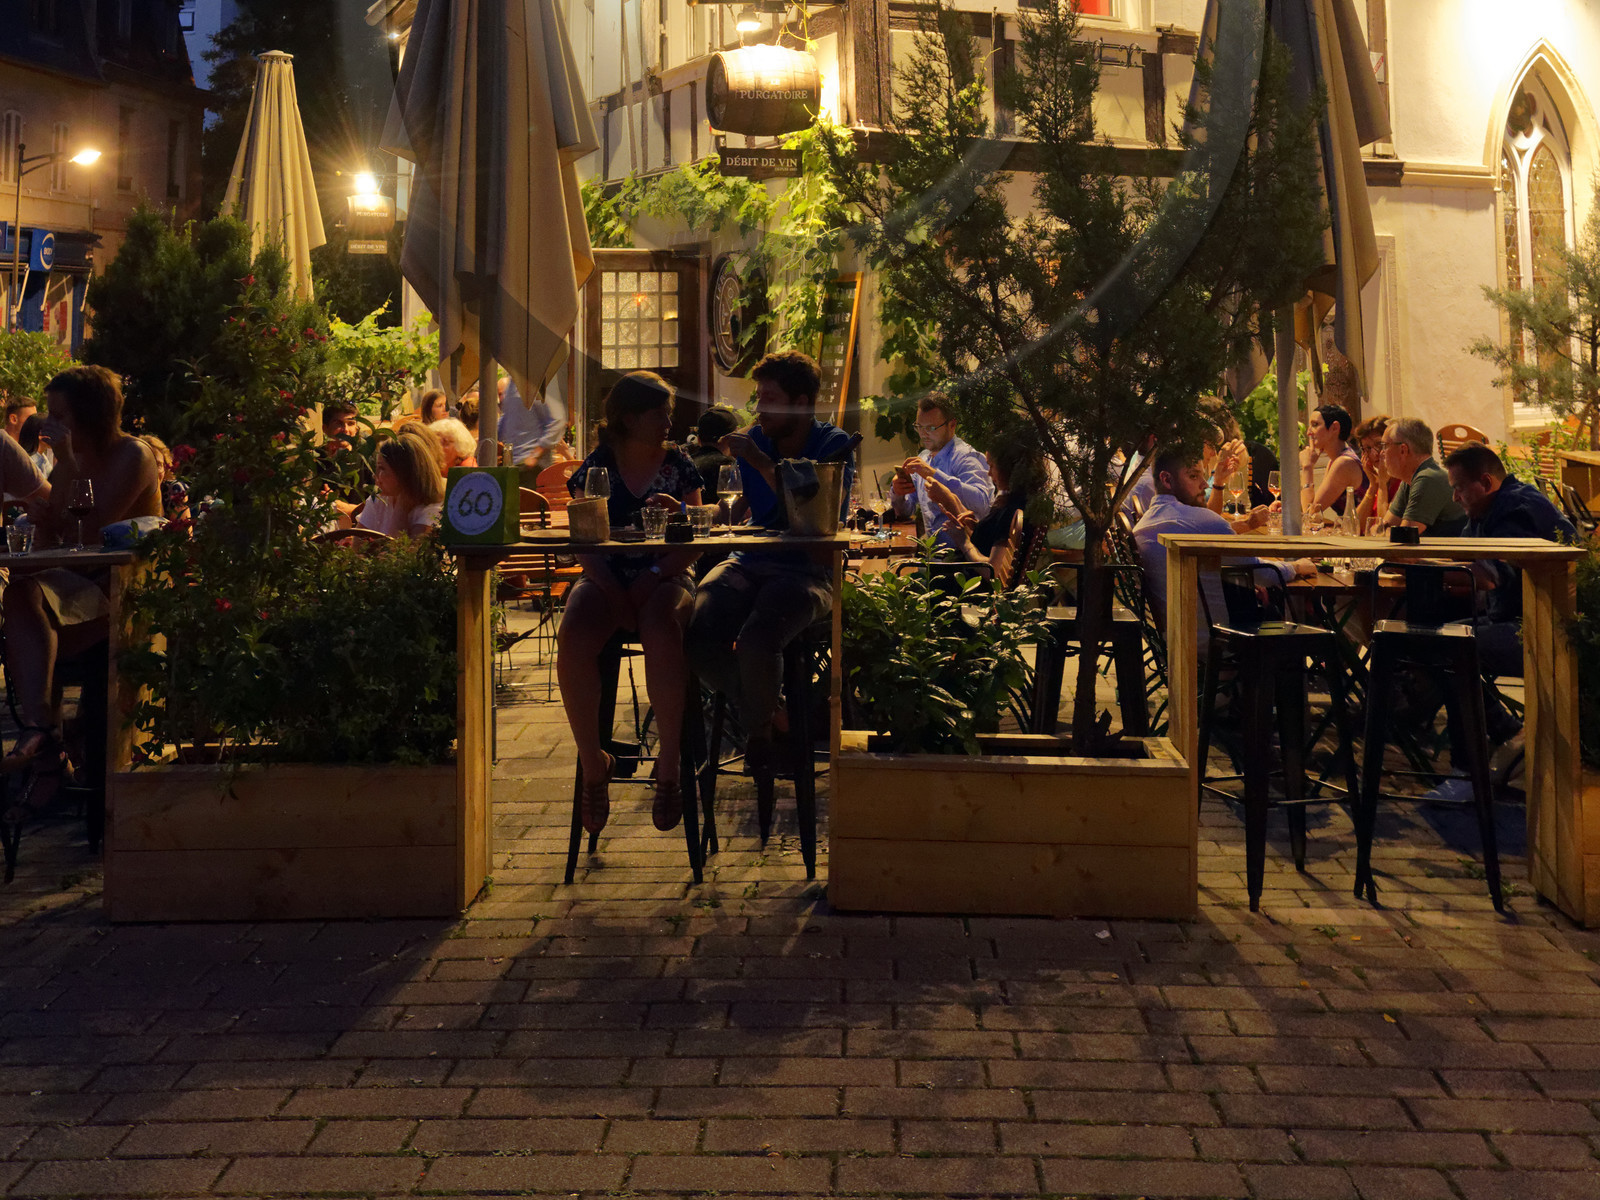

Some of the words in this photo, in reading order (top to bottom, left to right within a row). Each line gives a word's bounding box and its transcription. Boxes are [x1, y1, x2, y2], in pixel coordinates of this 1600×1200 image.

[740, 90, 808, 100] PURGATOIRE
[726, 154, 759, 166] DÉBIT
[761, 158, 776, 167] DE
[778, 158, 798, 168] VIN
[458, 488, 494, 517] 60
